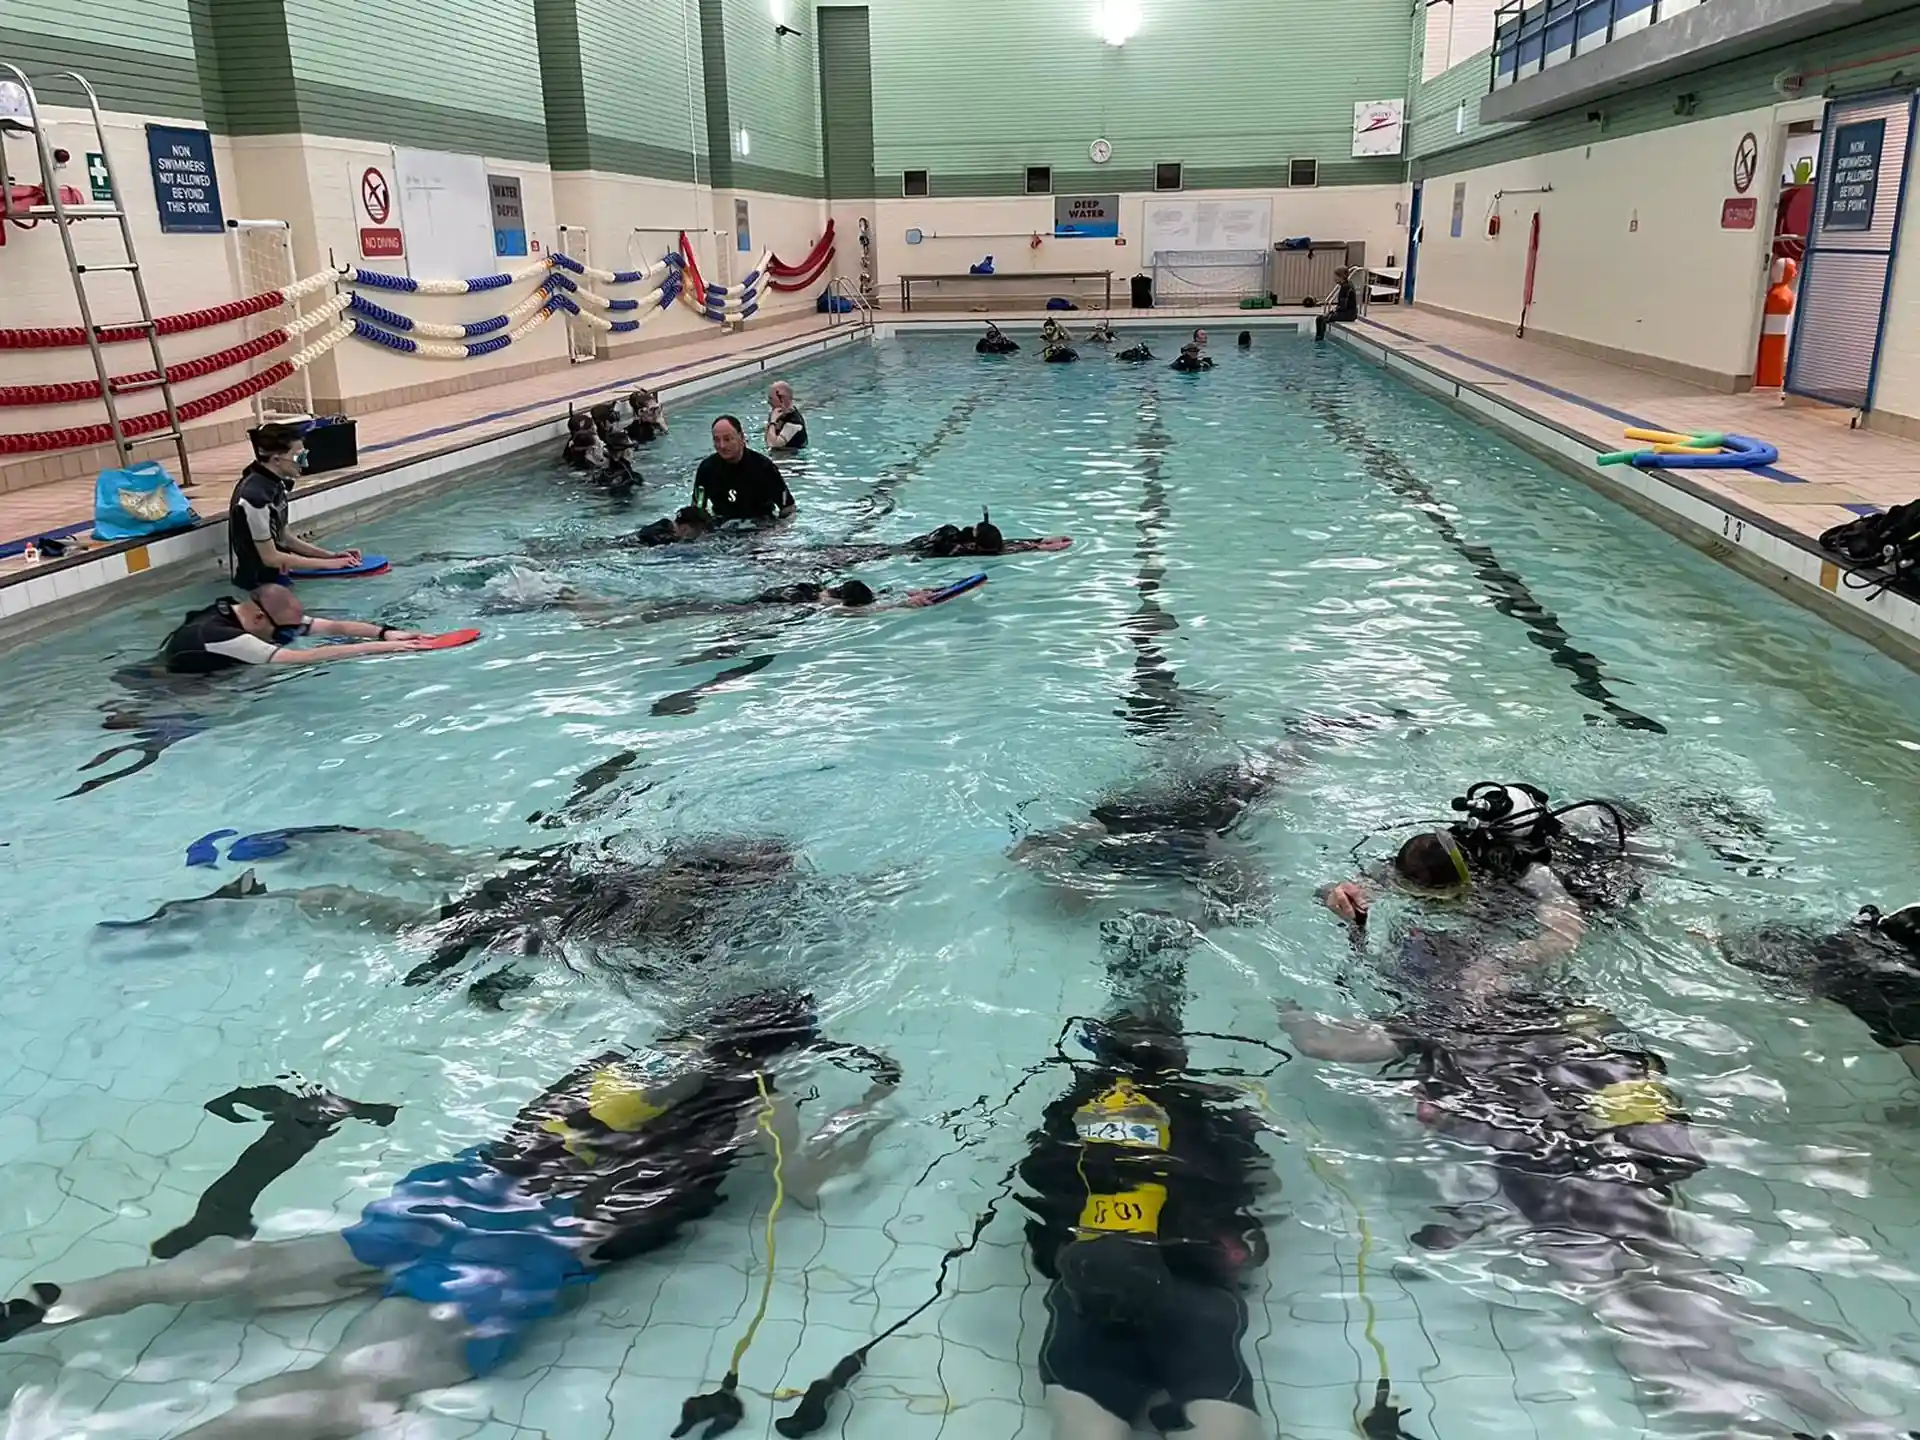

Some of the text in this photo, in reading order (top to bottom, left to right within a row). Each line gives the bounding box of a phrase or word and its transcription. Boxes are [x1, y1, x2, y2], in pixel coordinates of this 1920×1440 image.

[172, 145, 191, 157] NON
[1849, 140, 1865, 154] NON
[158, 157, 206, 173] SWIMMERS
[159, 172, 211, 187] NOT ALLOWED
[172, 187, 205, 200] BEYOND
[492, 184, 518, 199] WATER
[166, 201, 186, 213] THIS
[496, 203, 519, 217] DEPTH
[1074, 200, 1100, 209] DEEP
[1069, 209, 1105, 218] WATER
[365, 236, 400, 249] NO DIVING
[728, 488, 738, 503] S
